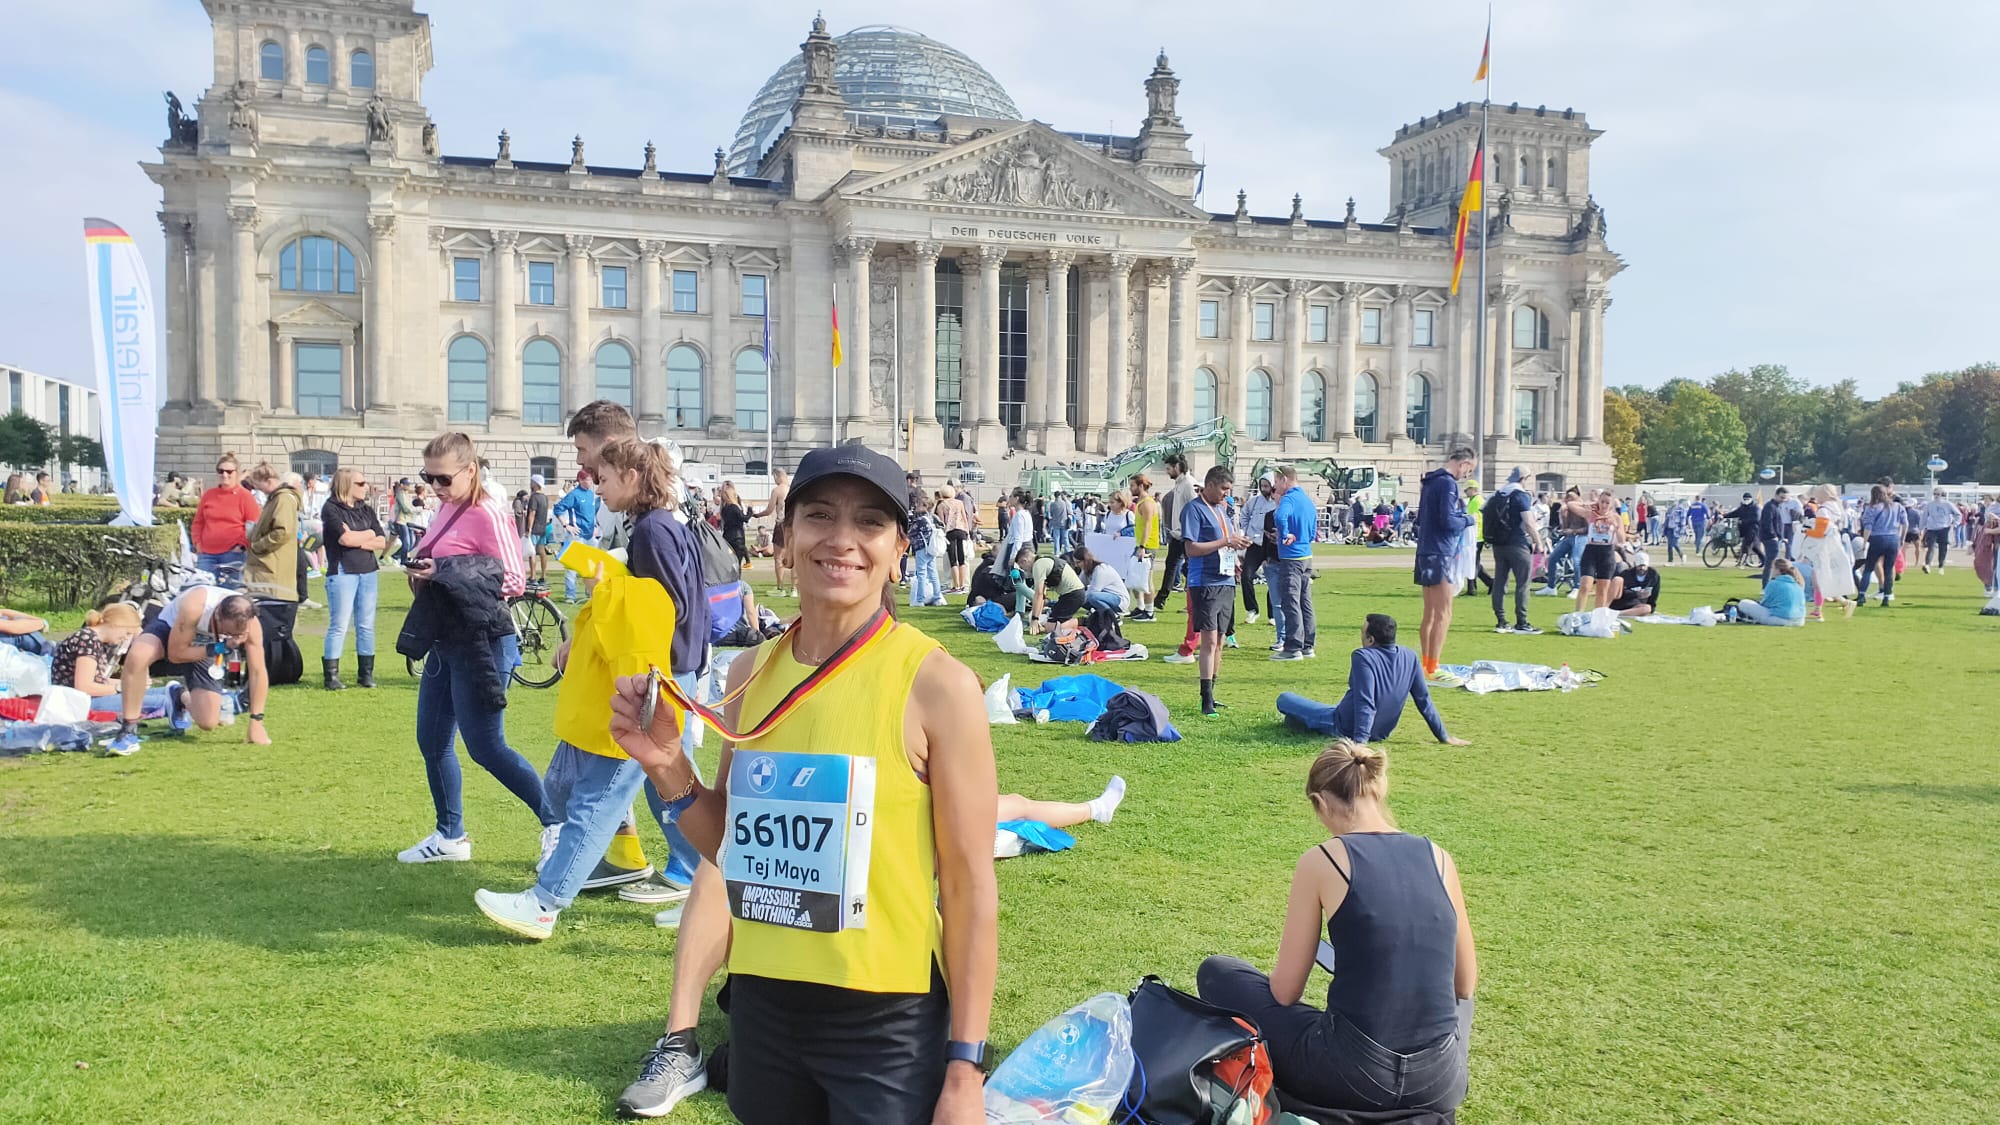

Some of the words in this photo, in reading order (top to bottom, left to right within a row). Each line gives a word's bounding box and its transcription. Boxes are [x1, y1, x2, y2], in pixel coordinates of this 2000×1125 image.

[951, 226, 978, 237] DEM
[988, 229, 1057, 242] DEUTSCHEN
[1066, 234, 1102, 245] VOLKE
[856, 812, 867, 826] D
[735, 811, 834, 853] 66107
[743, 855, 769, 880] Tej
[774, 858, 820, 885] Maya
[742, 885, 802, 909] IMPOSSIBLE
[741, 901, 751, 919] IS
[751, 902, 796, 925] NOTHING
